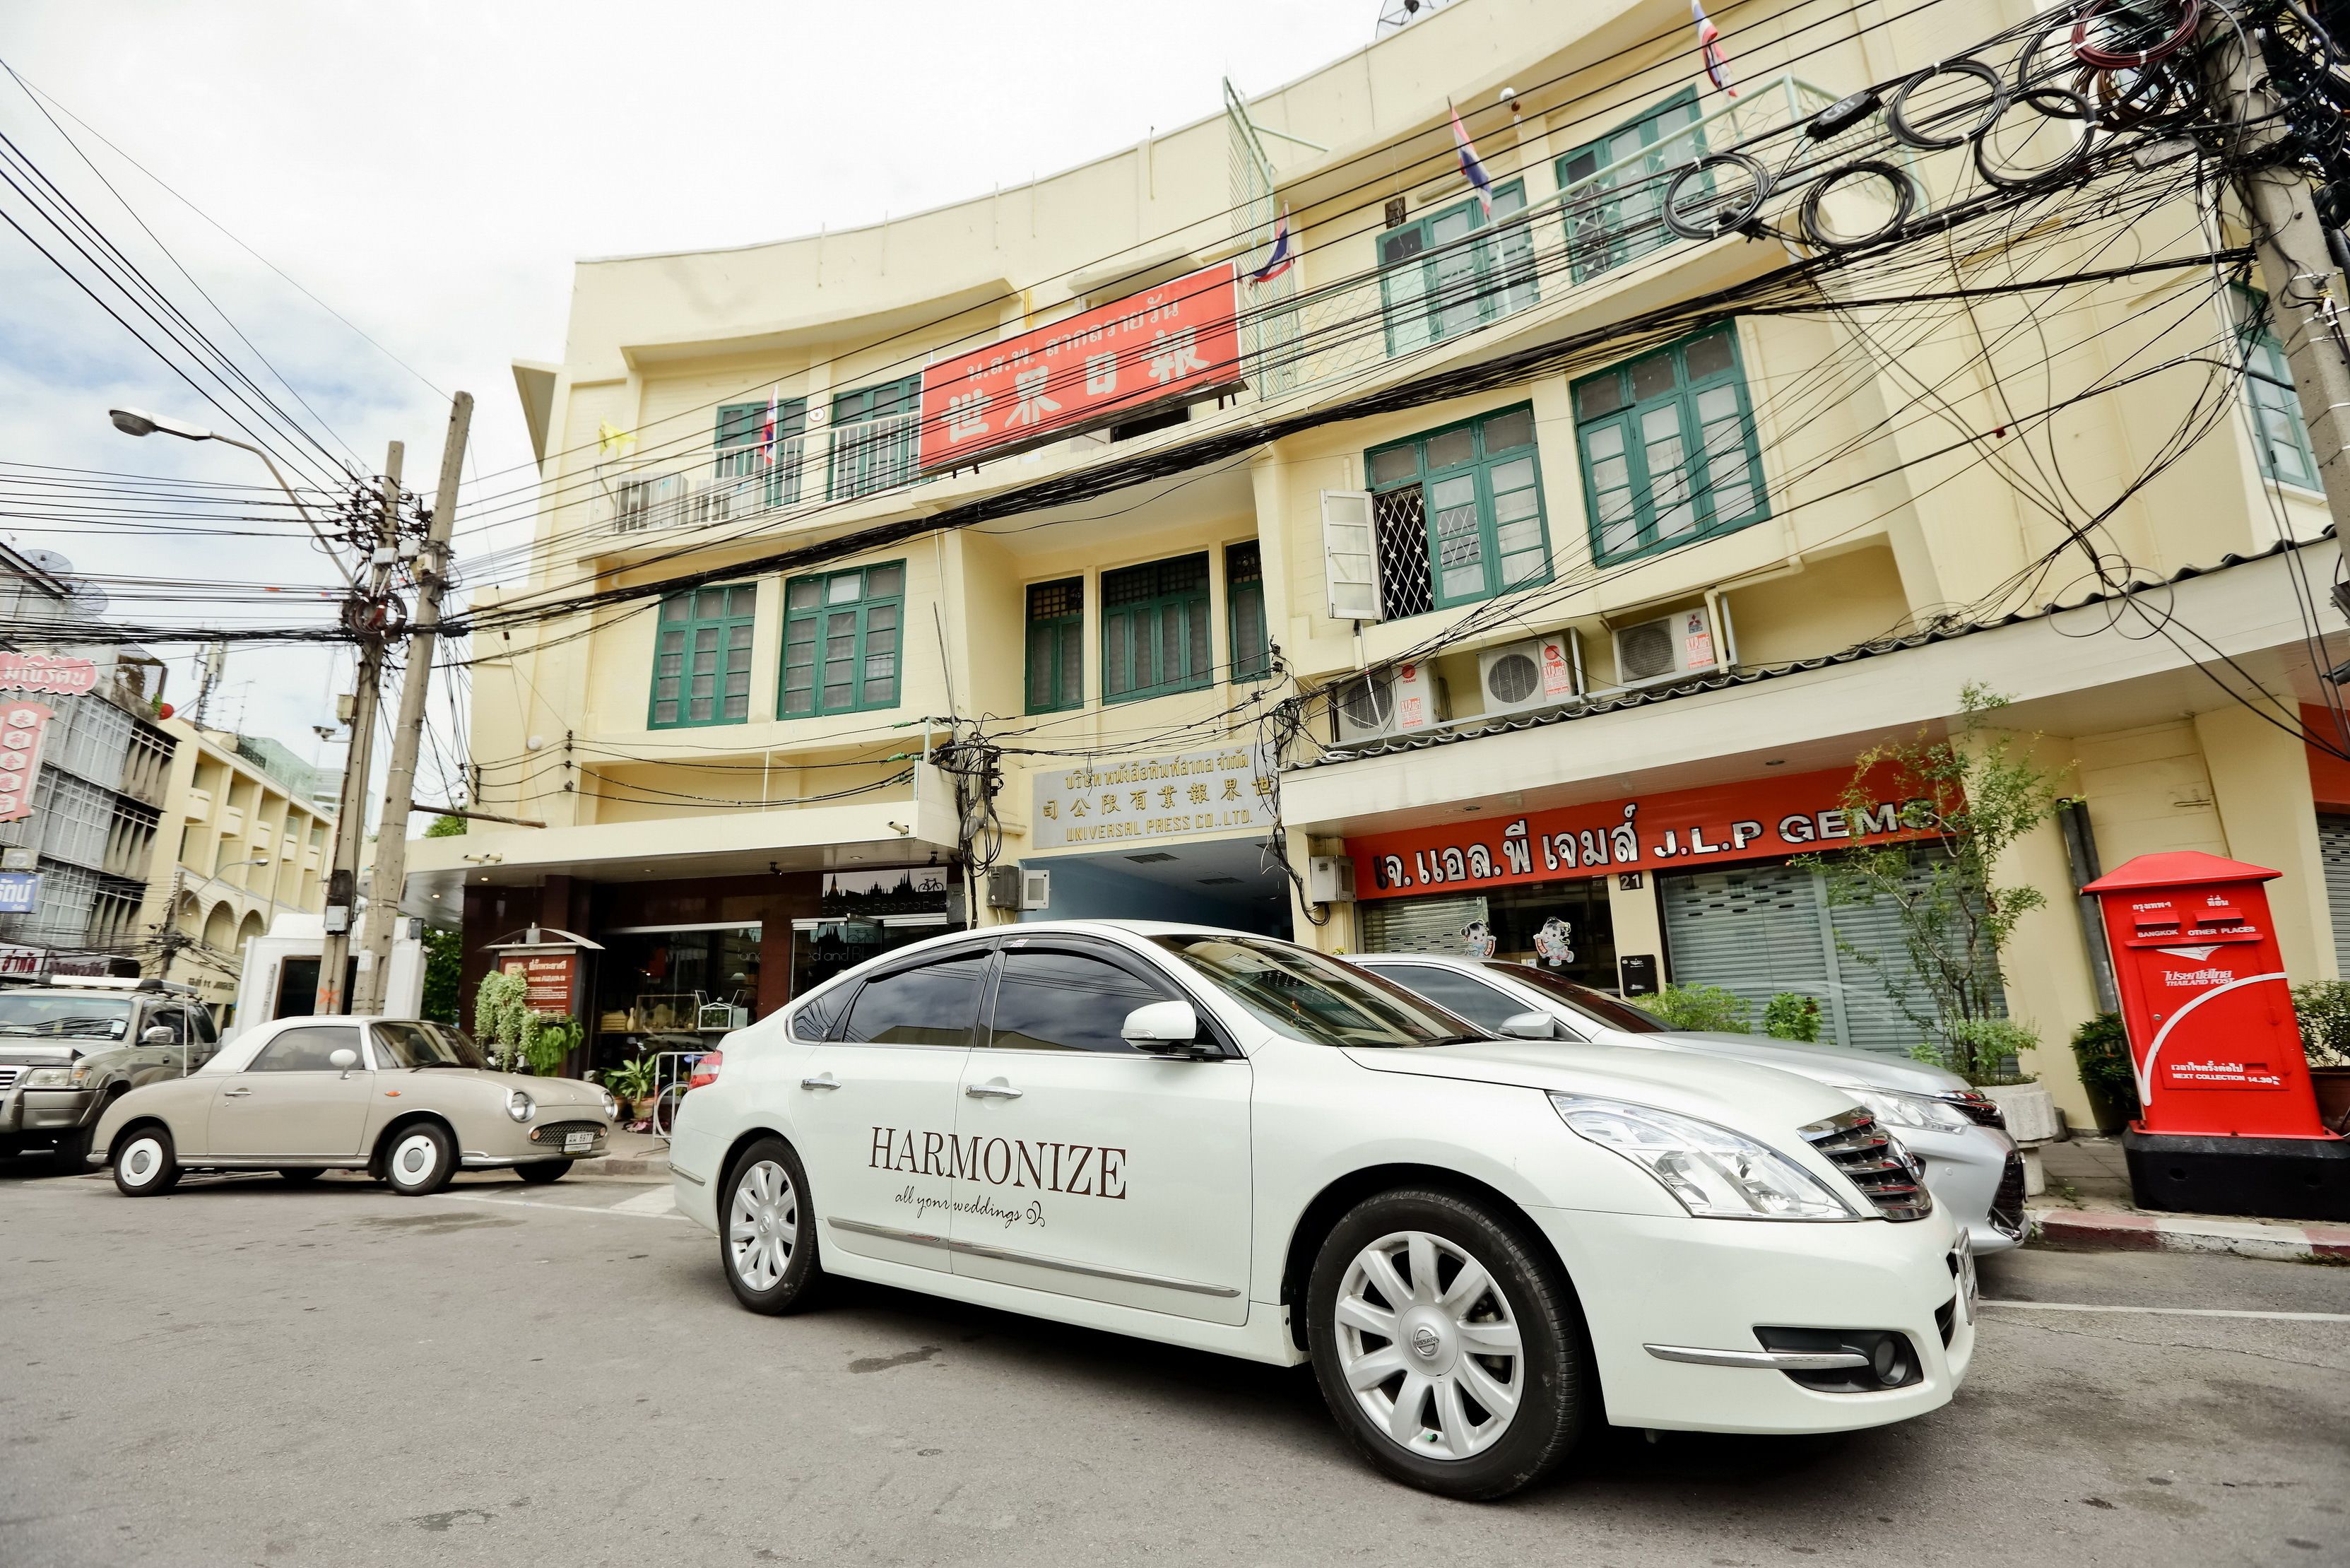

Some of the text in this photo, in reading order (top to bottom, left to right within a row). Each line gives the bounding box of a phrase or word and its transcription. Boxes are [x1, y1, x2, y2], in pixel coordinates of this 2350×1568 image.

[1044, 293, 1179, 357] สากลรายวัน
[1065, 748, 1248, 790] บริษัท หนังสือพิมพ์สากล จำกัด
[1066, 820, 1142, 842] UNIVERSAL
[1146, 815, 1191, 834] PRESS
[1542, 803, 1639, 871] เจมส์
[1620, 874, 1640, 890] 21
[2132, 895, 2229, 912] กรุงเทพฯ ที่อื่น
[2137, 929, 2179, 938] BANGKOK
[824, 945, 849, 962] and
[868, 1126, 1128, 1200] HARMONIZE
[895, 1186, 914, 1204] all
[952, 1194, 1023, 1230] weddings
